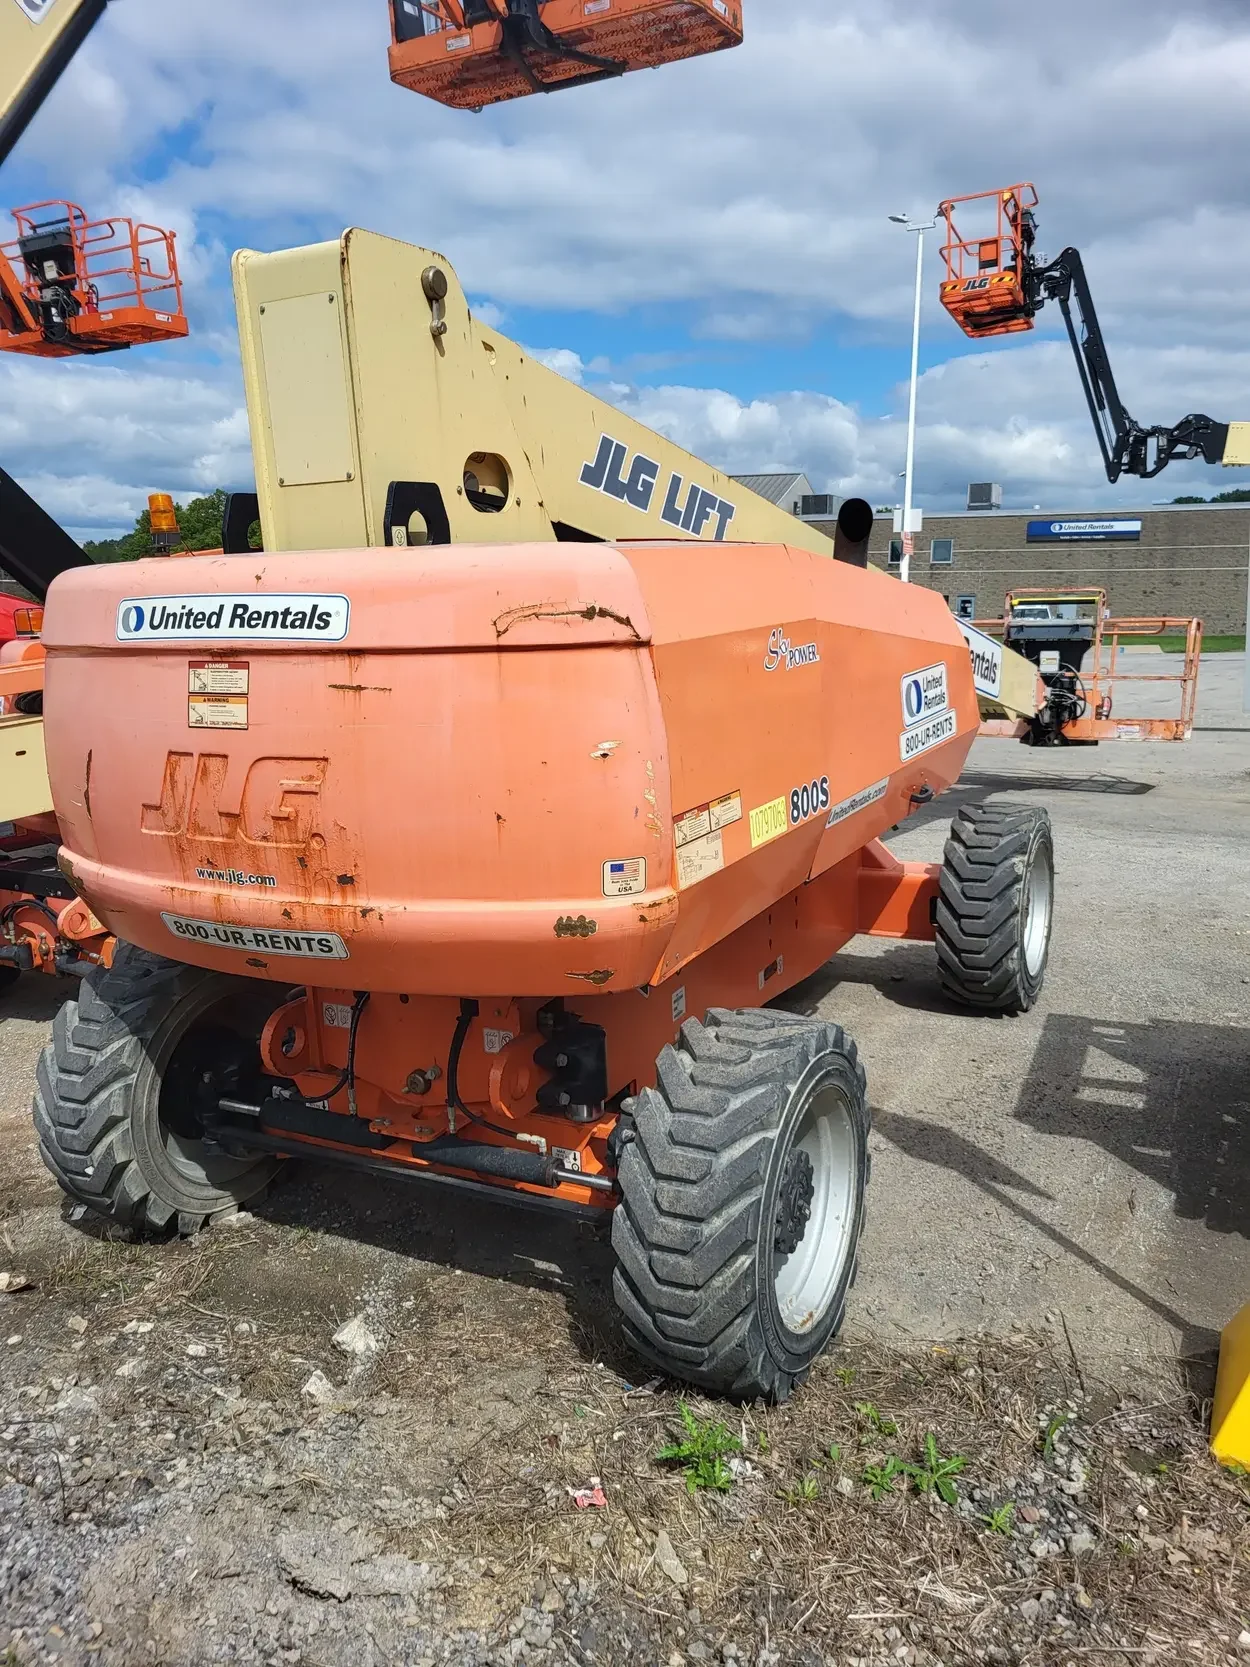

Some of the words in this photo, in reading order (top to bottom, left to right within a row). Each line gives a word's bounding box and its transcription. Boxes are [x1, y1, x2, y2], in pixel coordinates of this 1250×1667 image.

[961, 278, 990, 292] JLG
[579, 433, 660, 513] JLG
[660, 472, 735, 540] LIFT
[149, 604, 224, 630] United
[228, 603, 332, 630] Rentals
[789, 644, 817, 667] POWER
[967, 641, 997, 684] entals
[922, 671, 943, 693] United
[923, 690, 946, 712] Rentals
[905, 716, 953, 754] 800-UR-RENTS
[140, 749, 330, 849] JLG
[791, 777, 829, 823] 800S
[827, 784, 887, 825] UnitedRentals.com
[750, 800, 786, 840] 10797063
[196, 866, 277, 887] www.jlg.com
[173, 920, 334, 955] 800-UR-RENTS
